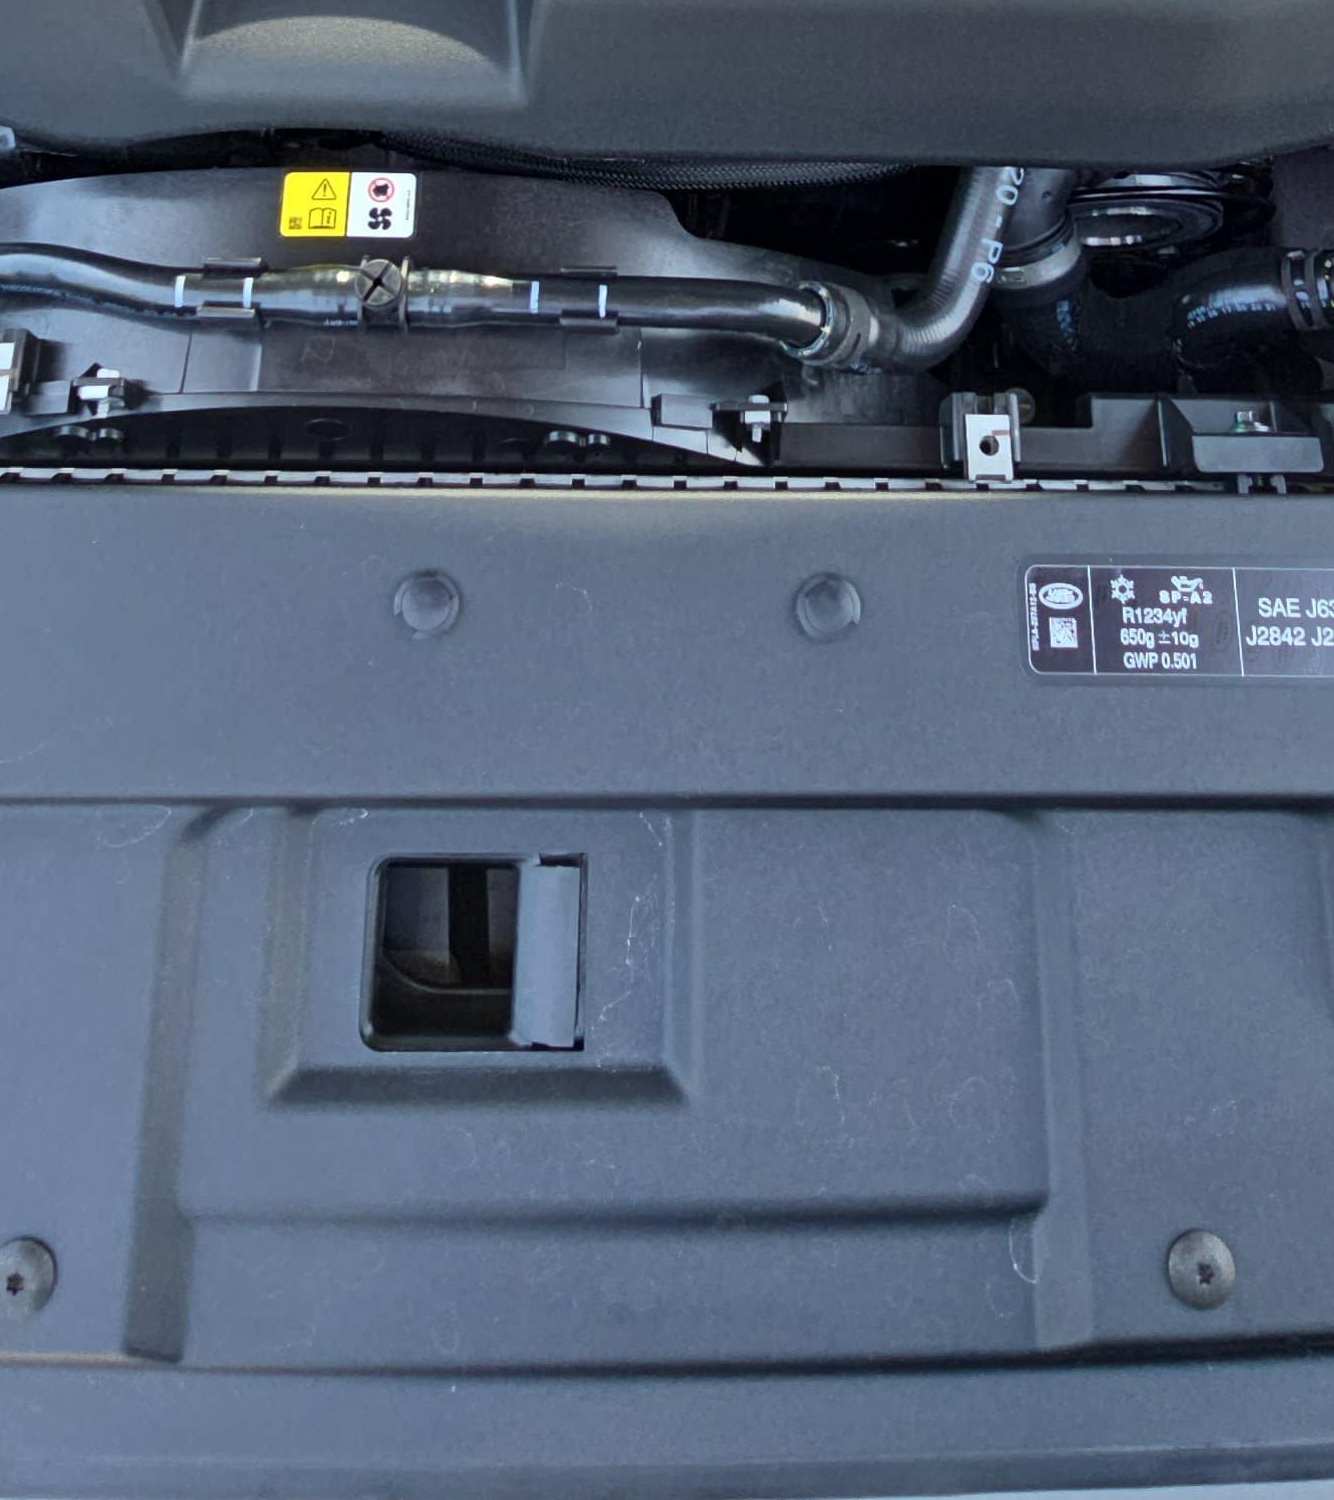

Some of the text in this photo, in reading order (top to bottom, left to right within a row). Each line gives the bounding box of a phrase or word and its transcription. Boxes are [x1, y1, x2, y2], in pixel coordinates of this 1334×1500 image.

[970, 238, 1003, 284] P6
[1122, 607, 1188, 626] R1234yf
[1257, 597, 1301, 618] SAE
[1120, 629, 1155, 649] 650g
[1245, 626, 1306, 647] J2842
[1123, 652, 1198, 669] GWP 0.501
